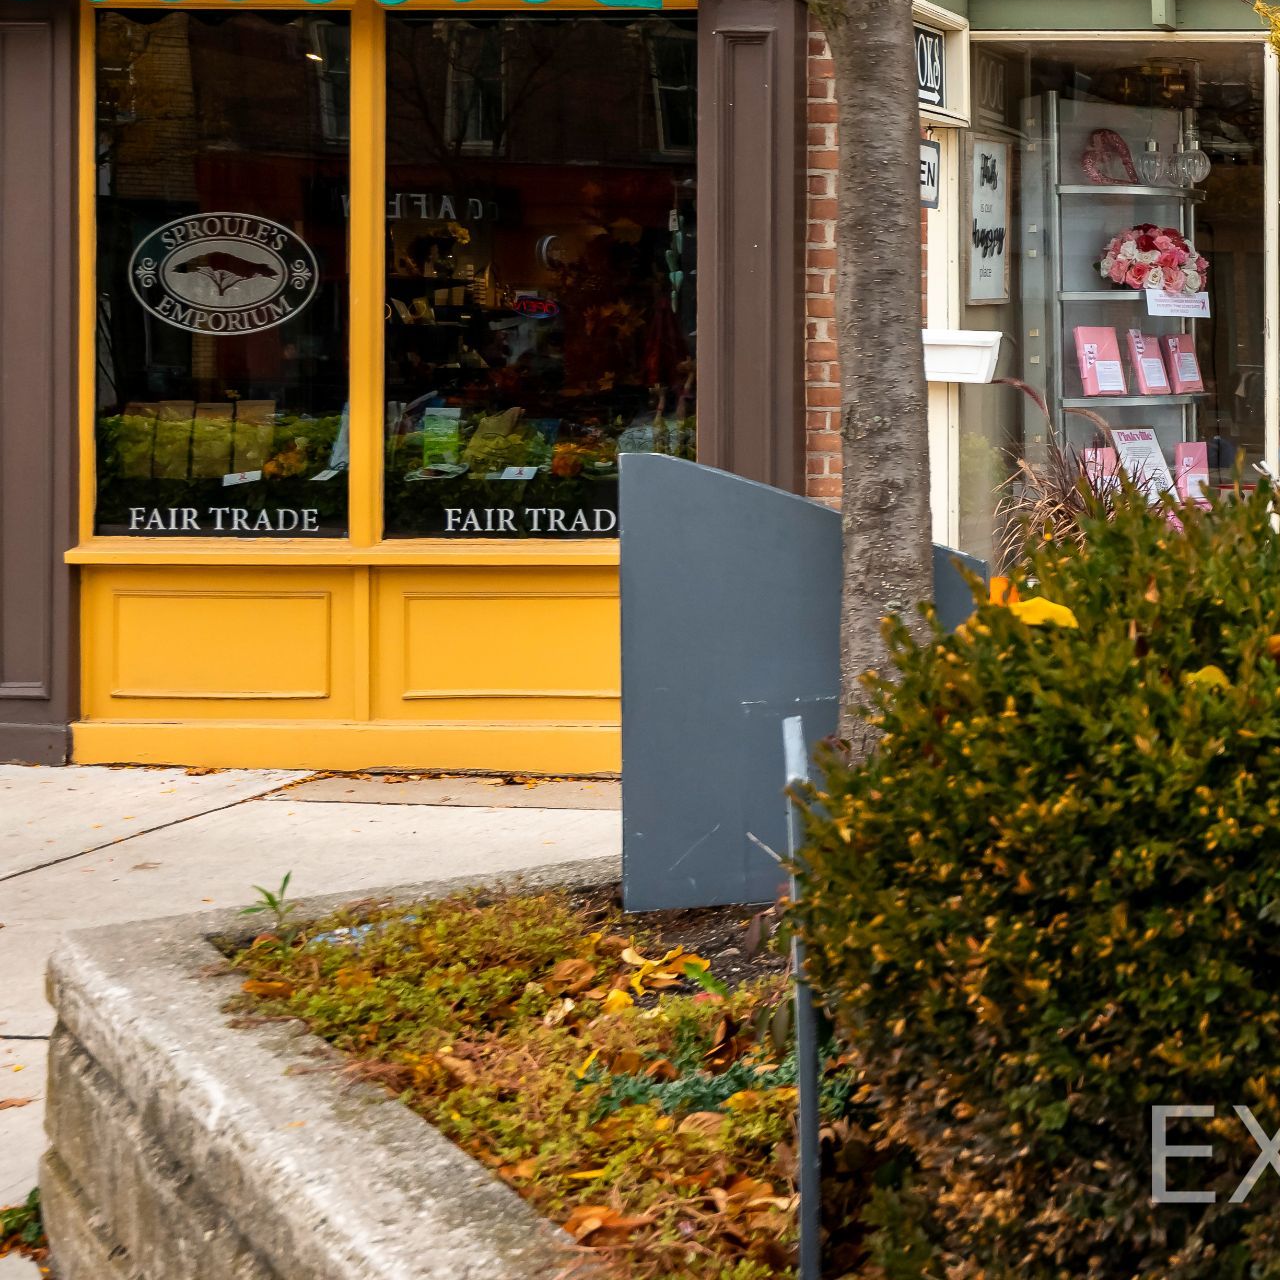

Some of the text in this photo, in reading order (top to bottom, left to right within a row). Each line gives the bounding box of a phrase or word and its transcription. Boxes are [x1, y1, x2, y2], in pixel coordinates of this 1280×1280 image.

[917, 33, 941, 91] OKS
[920, 161, 936, 188] EN
[161, 217, 288, 251] SPROULE'S
[154, 294, 294, 332] EMPORIUM
[128, 507, 320, 532] FAIR TRADE
[444, 508, 617, 532] FAIR TRAD
